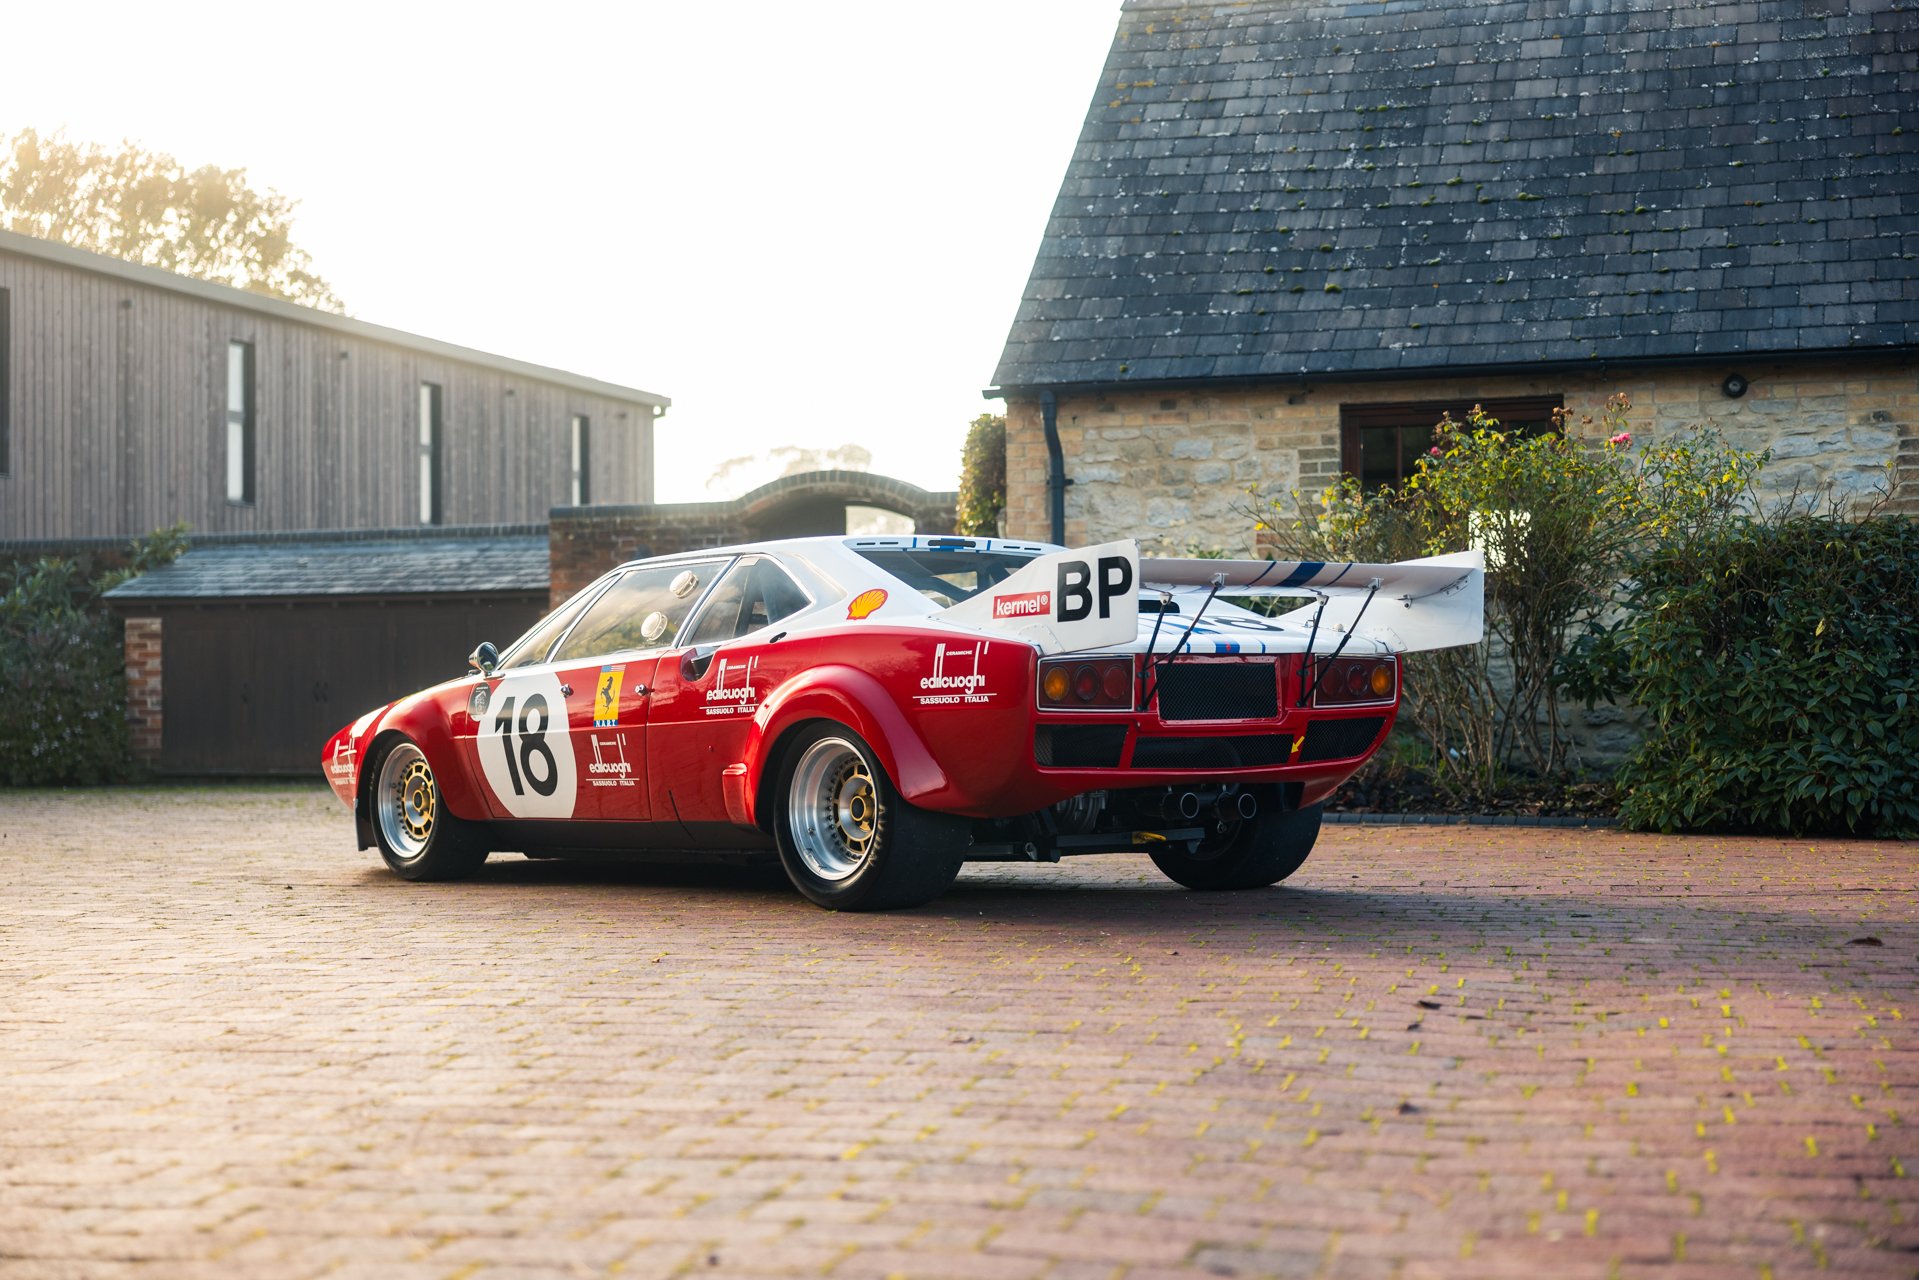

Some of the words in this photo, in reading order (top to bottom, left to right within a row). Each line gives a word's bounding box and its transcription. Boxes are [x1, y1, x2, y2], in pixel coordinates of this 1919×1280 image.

[1057, 556, 1132, 622] BP
[920, 641, 989, 694] edilcuoghi
[706, 707, 734, 715] SASSUOLO
[920, 696, 960, 704] SASSUOLO
[965, 695, 989, 703] ITALIA
[495, 693, 558, 796] 18
